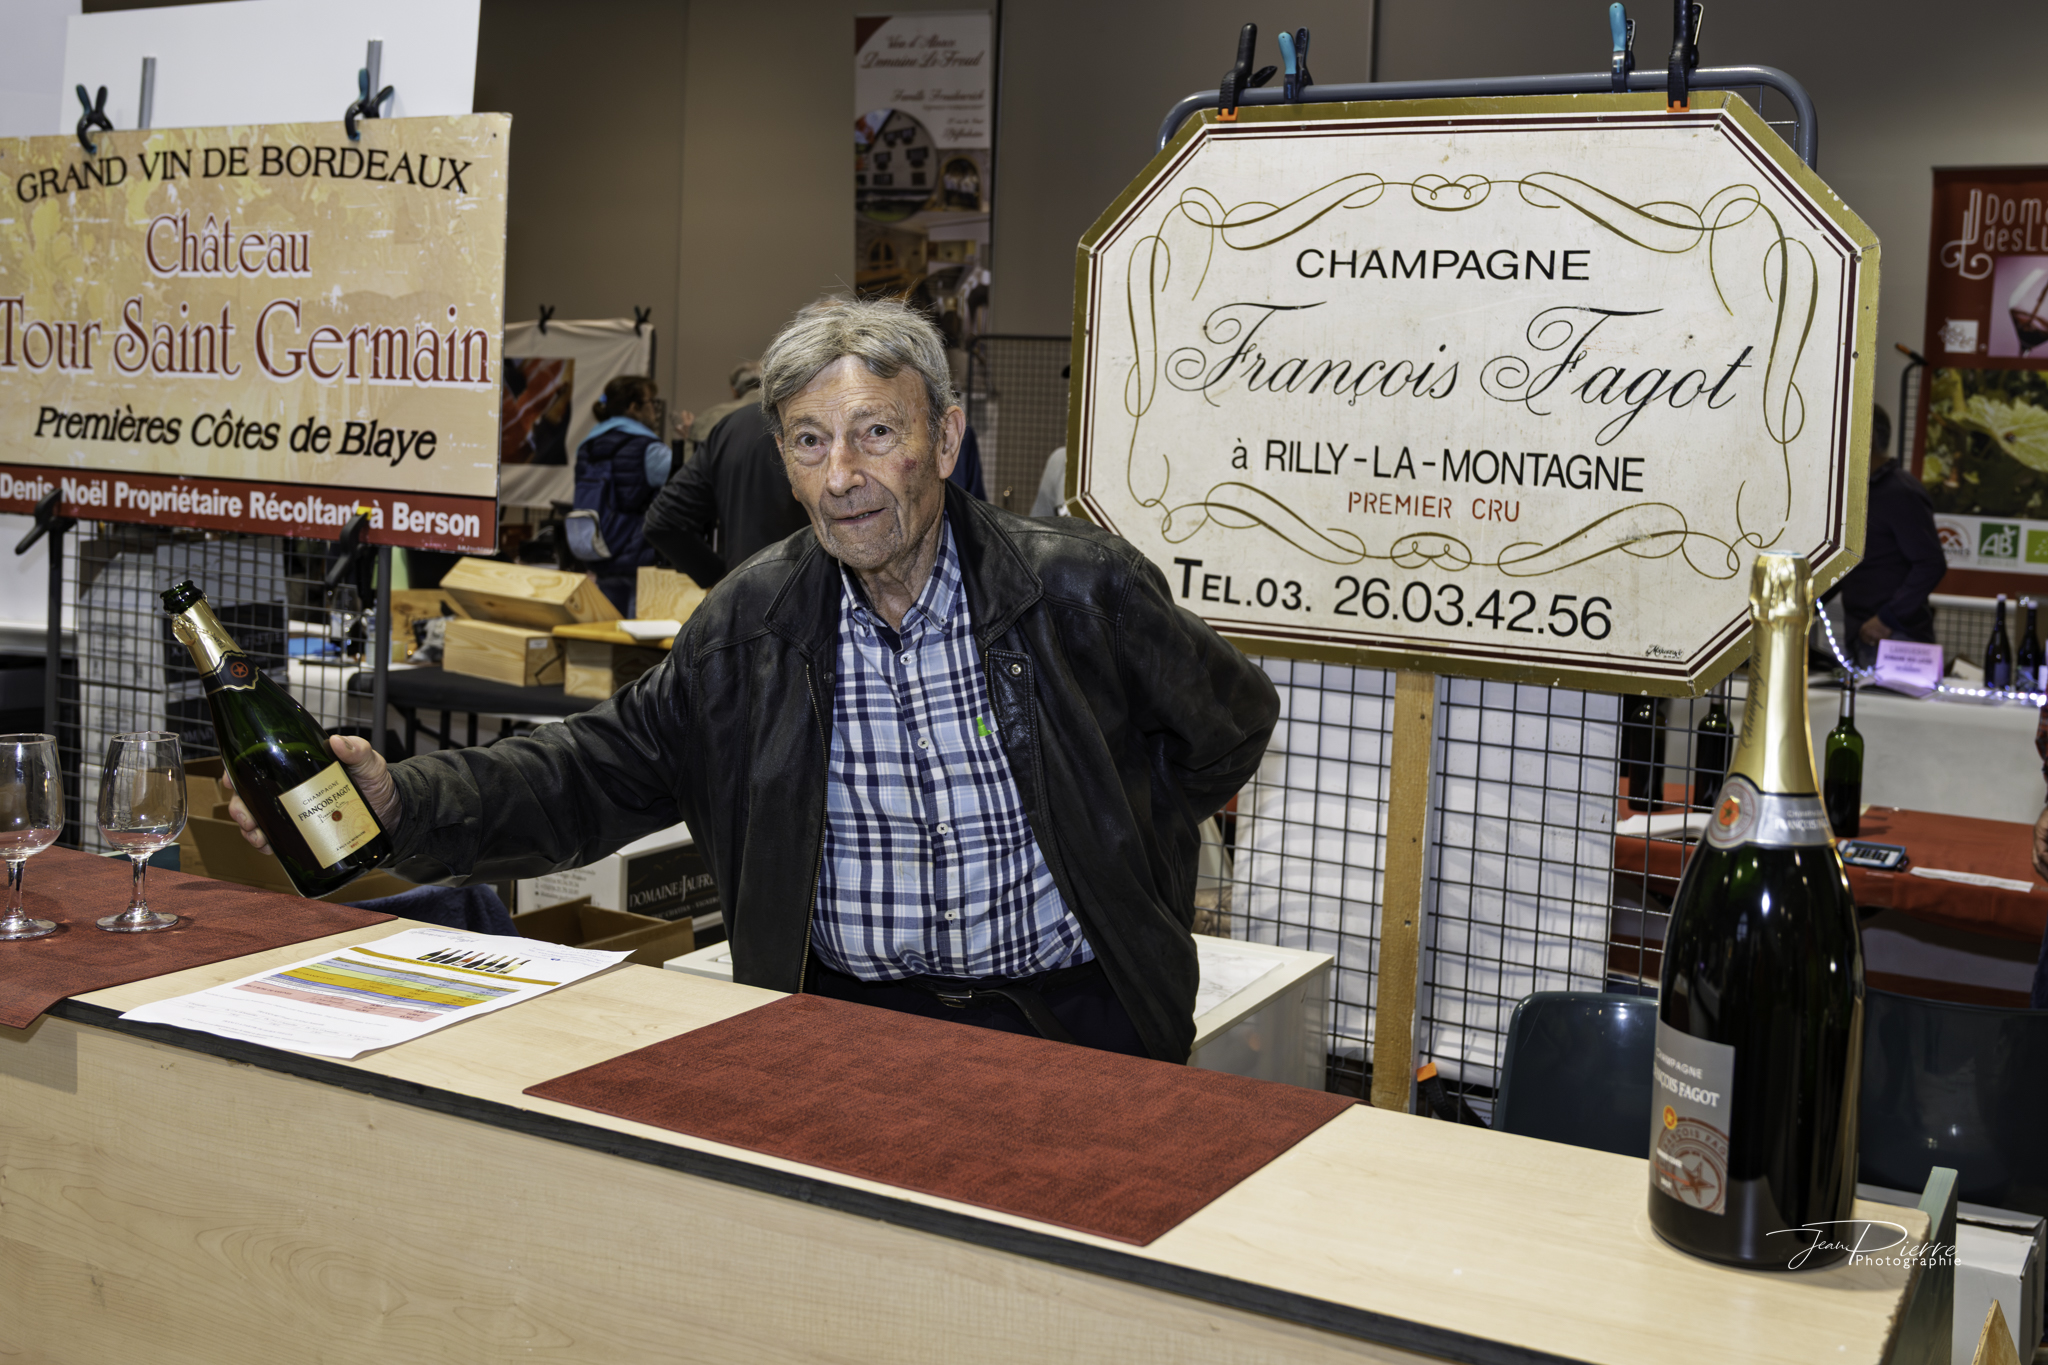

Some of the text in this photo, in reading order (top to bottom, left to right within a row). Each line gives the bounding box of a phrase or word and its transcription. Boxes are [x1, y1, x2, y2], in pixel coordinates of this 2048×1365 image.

[16, 146, 473, 203] GRAND VIN DE BORDEAUX
[1985, 193, 2048, 226] Dom
[146, 211, 312, 275] Château
[1296, 248, 1592, 281] CHAMPAGNE
[0, 296, 492, 384] Tour Saint Germain
[1165, 301, 1754, 446] François Fagot
[34, 404, 437, 467] Premières Côtes de Blaye
[1231, 438, 1248, 469] à
[61, 477, 108, 506] Noël
[114, 481, 244, 518] Propriétaire
[369, 499, 384, 530] à
[392, 501, 480, 537] Berson
[1347, 491, 1521, 523] PREMIER CRU
[1333, 575, 1613, 640] 26.03.42.56
[297, 784, 351, 822] FRANÇOIS FAGOT
[303, 780, 339, 806] CHAMPAGNE
[629, 882, 679, 909] DOMAINE
[1678, 1081, 1721, 1107] FAGOT
